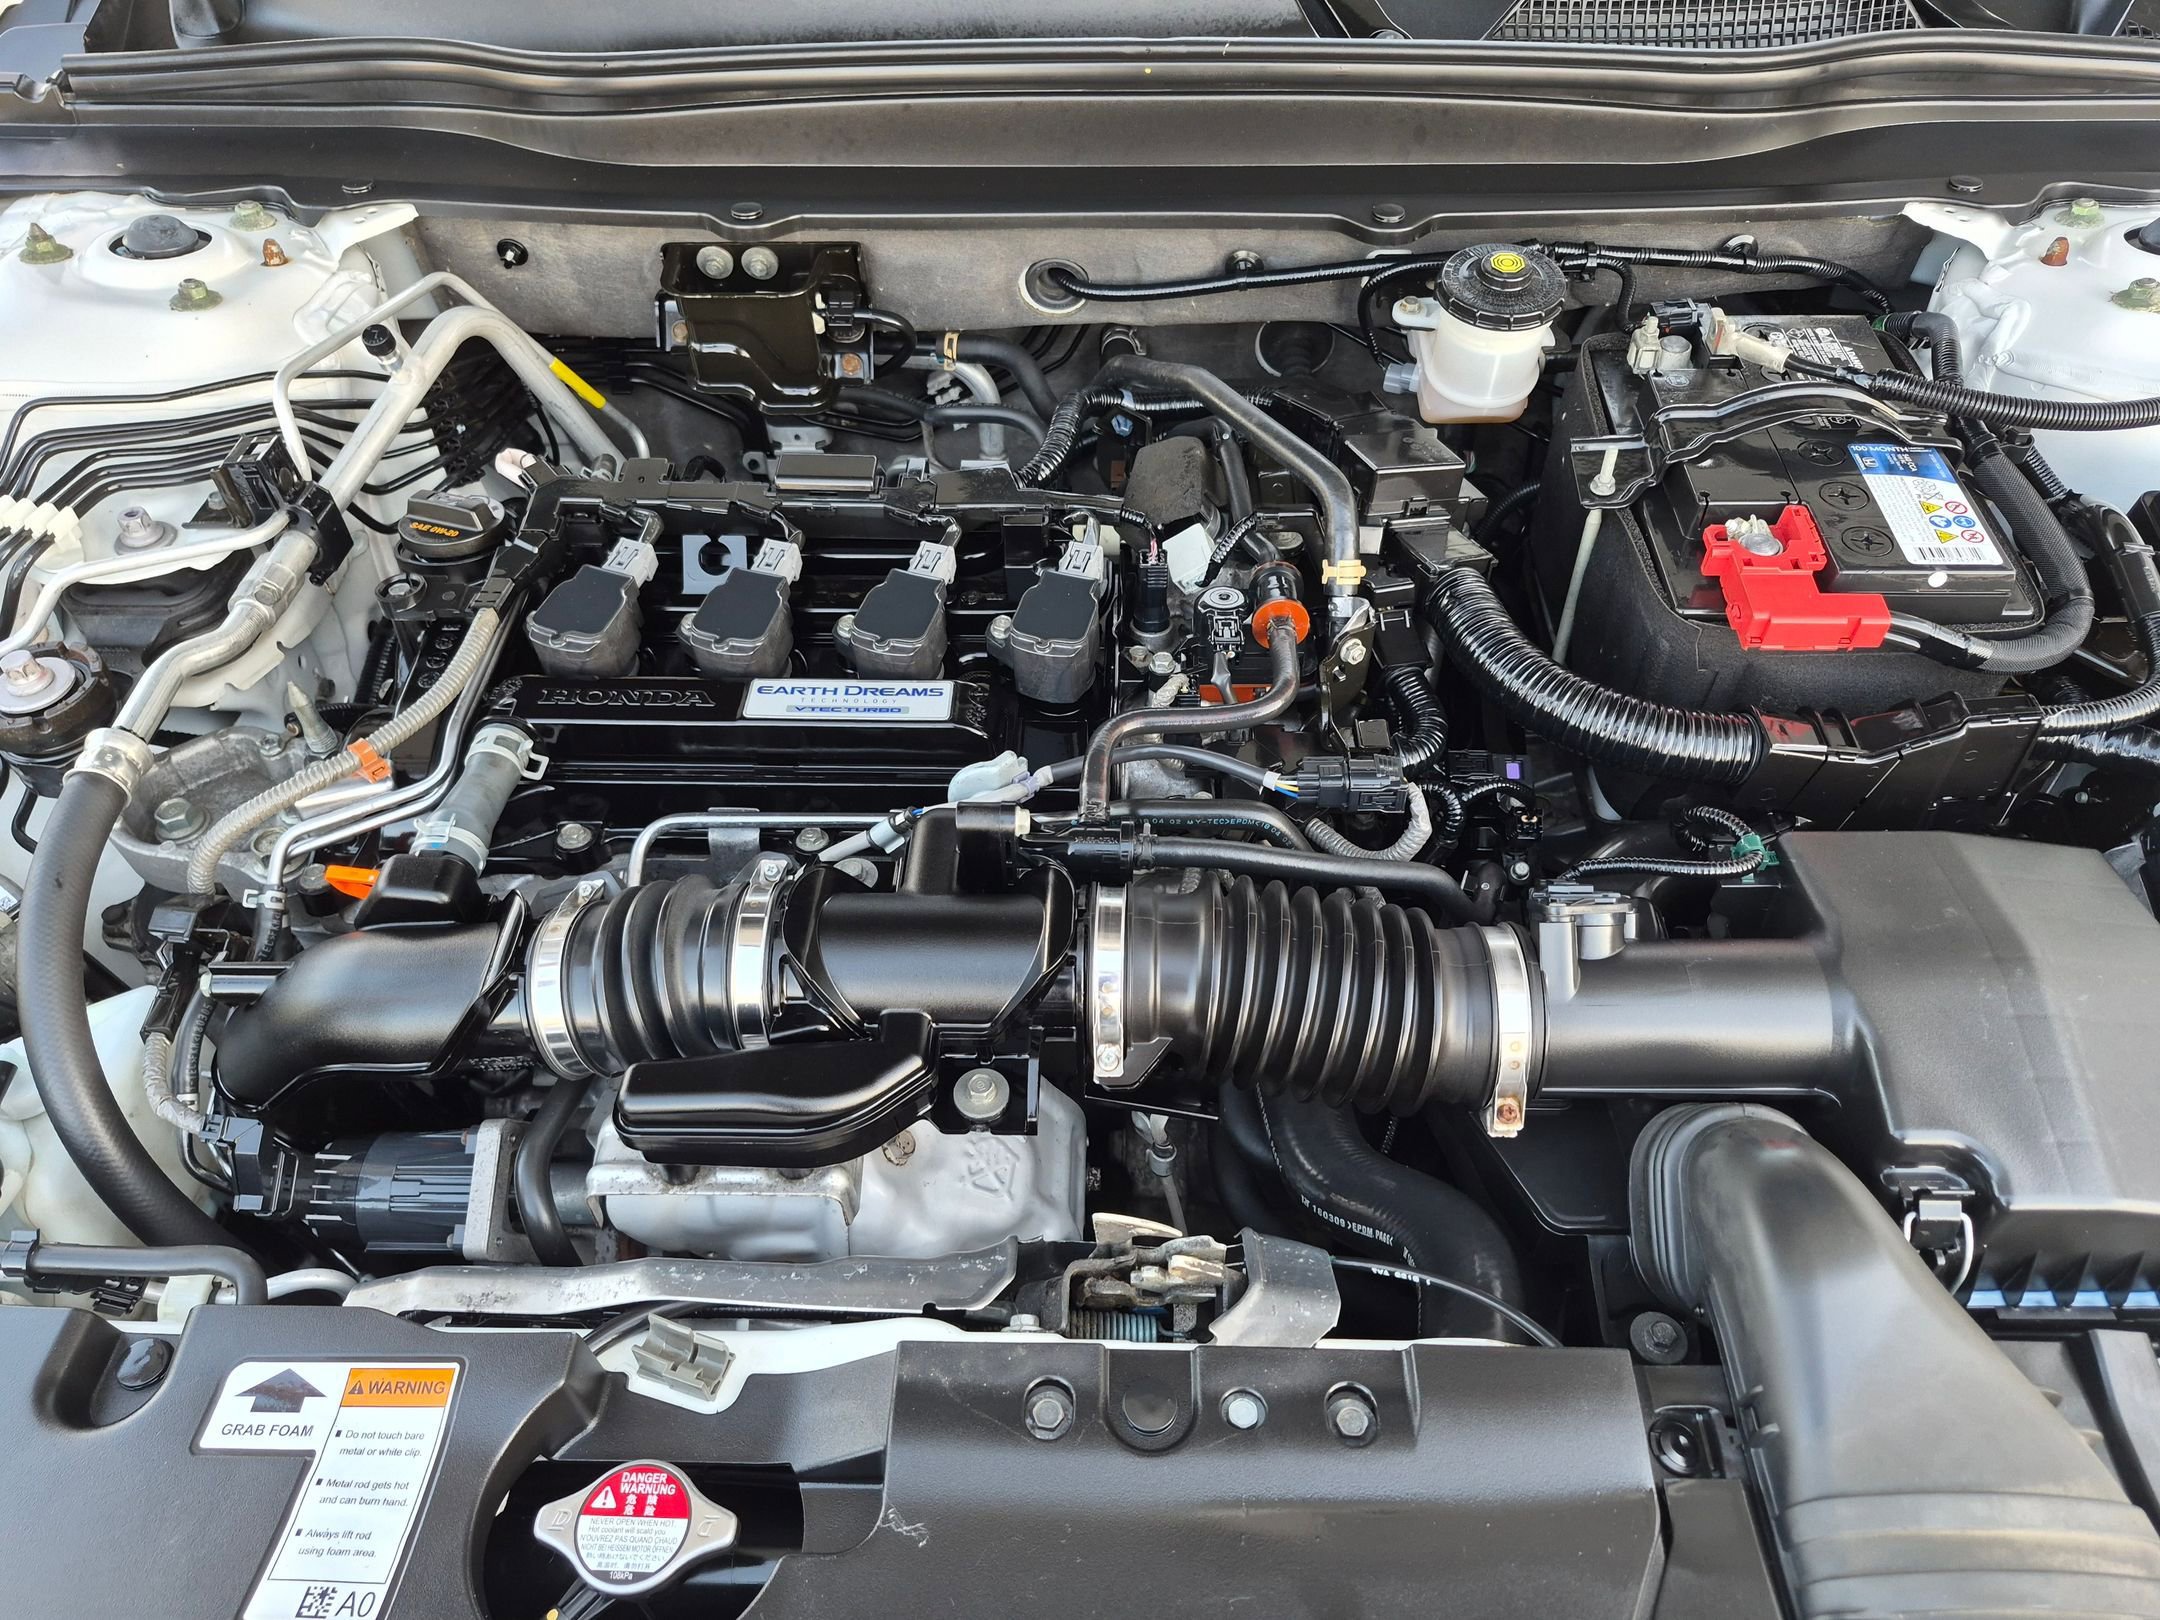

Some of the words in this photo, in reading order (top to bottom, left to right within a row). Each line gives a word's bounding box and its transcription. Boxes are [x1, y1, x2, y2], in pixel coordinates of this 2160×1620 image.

[409, 522, 431, 532] SAE
[430, 525, 460, 537] 0W-20
[757, 685, 838, 696] EARTH
[844, 686, 944, 697] DREAMS
[537, 688, 716, 707] HONDA
[368, 1380, 446, 1395] WARNING
[221, 1423, 266, 1436] GRAB
[268, 1424, 315, 1437] FOAM
[345, 1430, 359, 1439] Do
[361, 1430, 376, 1440] not
[377, 1431, 402, 1440] touch
[404, 1432, 425, 1440] bare
[339, 1447, 365, 1456] metal
[378, 1448, 402, 1456] white
[404, 1449, 423, 1458] clip.
[621, 1471, 667, 1483] DANGER
[326, 1479, 352, 1488] Metal
[354, 1480, 370, 1489] rod
[371, 1480, 392, 1491] gets
[393, 1481, 409, 1490] hot
[620, 1483, 677, 1495] WARNUNG
[319, 1495, 338, 1504] and
[359, 1497, 380, 1506] burn
[382, 1498, 409, 1507] hand.
[590, 1517, 613, 1525] NEVER
[616, 1518, 635, 1526] OPEN
[637, 1519, 659, 1527] WHEN
[305, 1529, 340, 1541] Always
[341, 1530, 354, 1540] lift
[355, 1531, 371, 1540] rod
[601, 1526, 624, 1534] coolant
[636, 1527, 652, 1535] scald
[580, 1534, 613, 1542] N'OUVREZ
[614, 1535, 628, 1543] PAS
[629, 1536, 653, 1544] QUAND
[298, 1547, 325, 1557] using
[326, 1547, 351, 1556] foam
[352, 1550, 376, 1558] area.
[335, 1591, 376, 1618] A0
